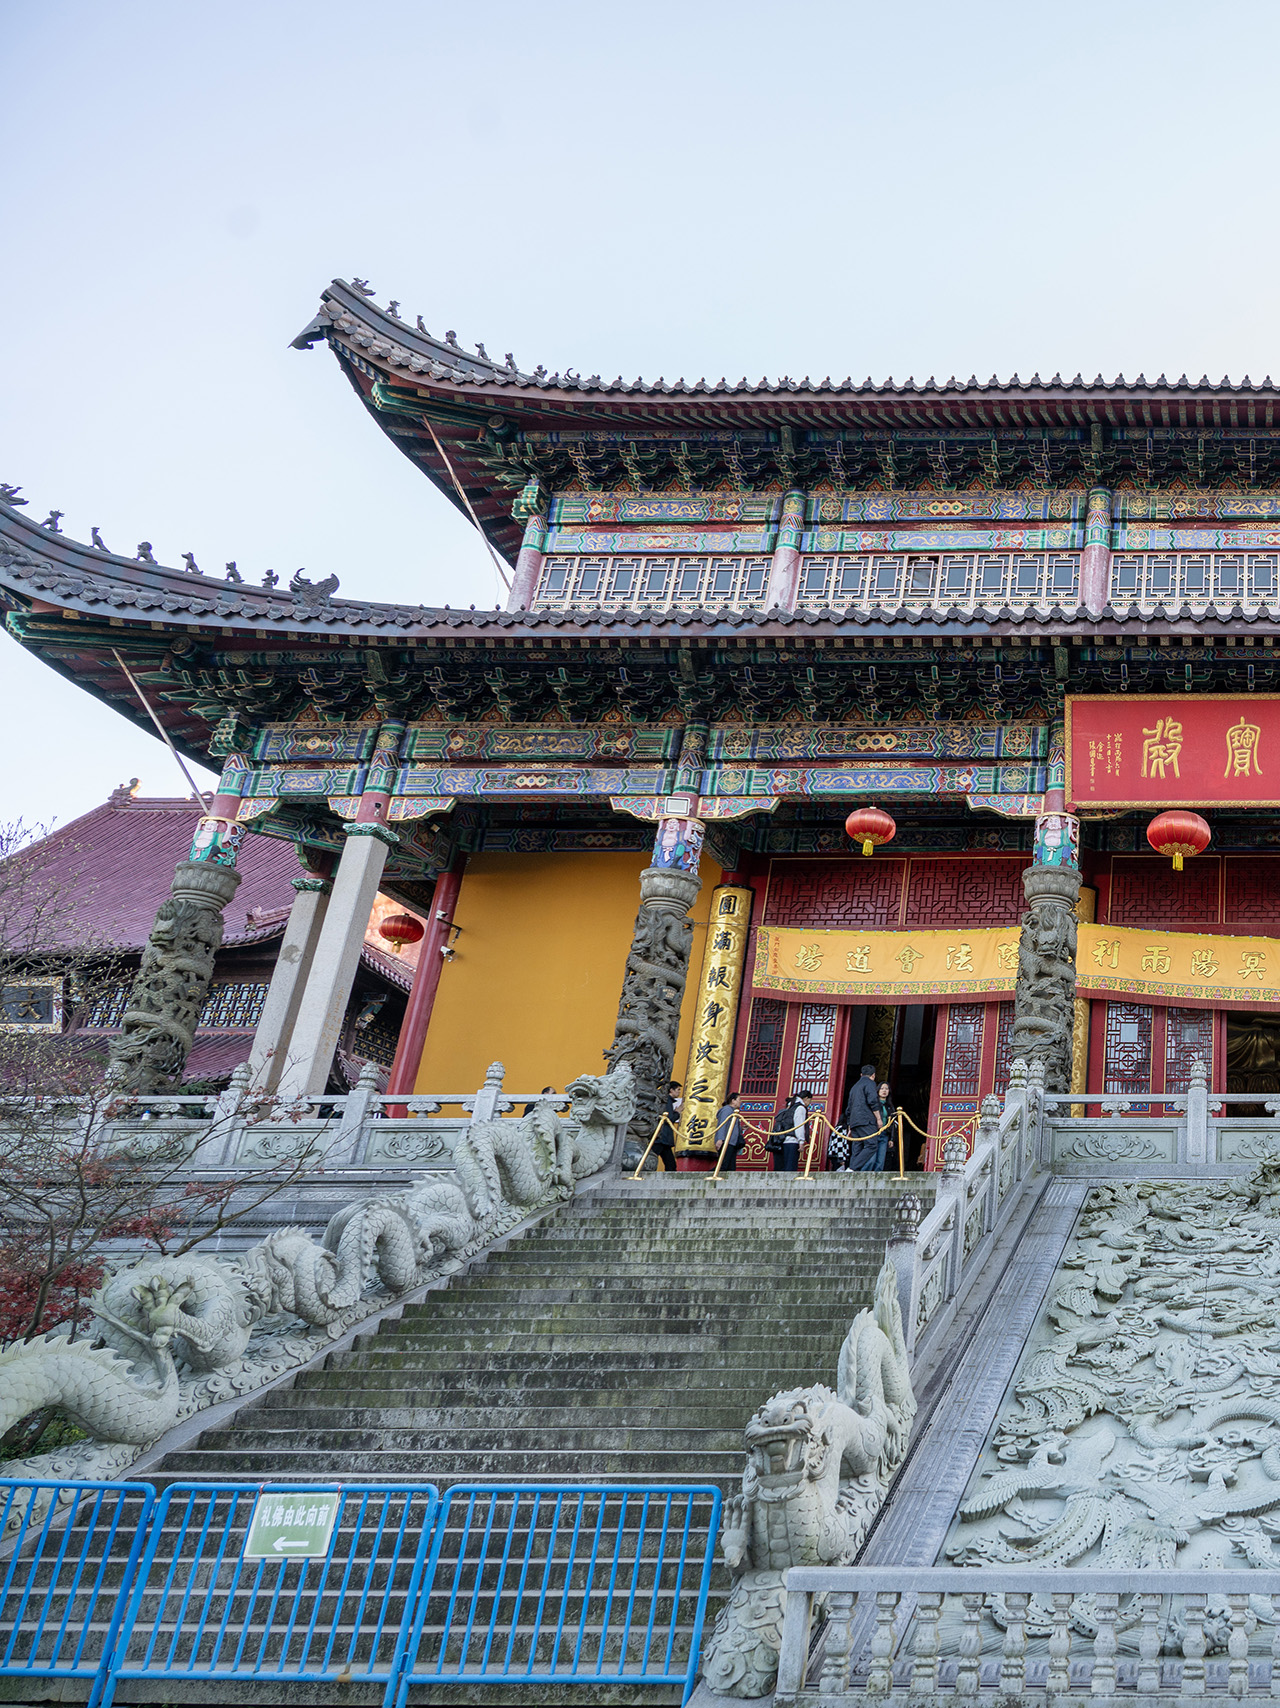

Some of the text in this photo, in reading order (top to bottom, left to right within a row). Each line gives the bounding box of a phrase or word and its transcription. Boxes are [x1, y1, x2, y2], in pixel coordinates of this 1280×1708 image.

[261, 1504, 330, 1528] 礼佛由此向前
